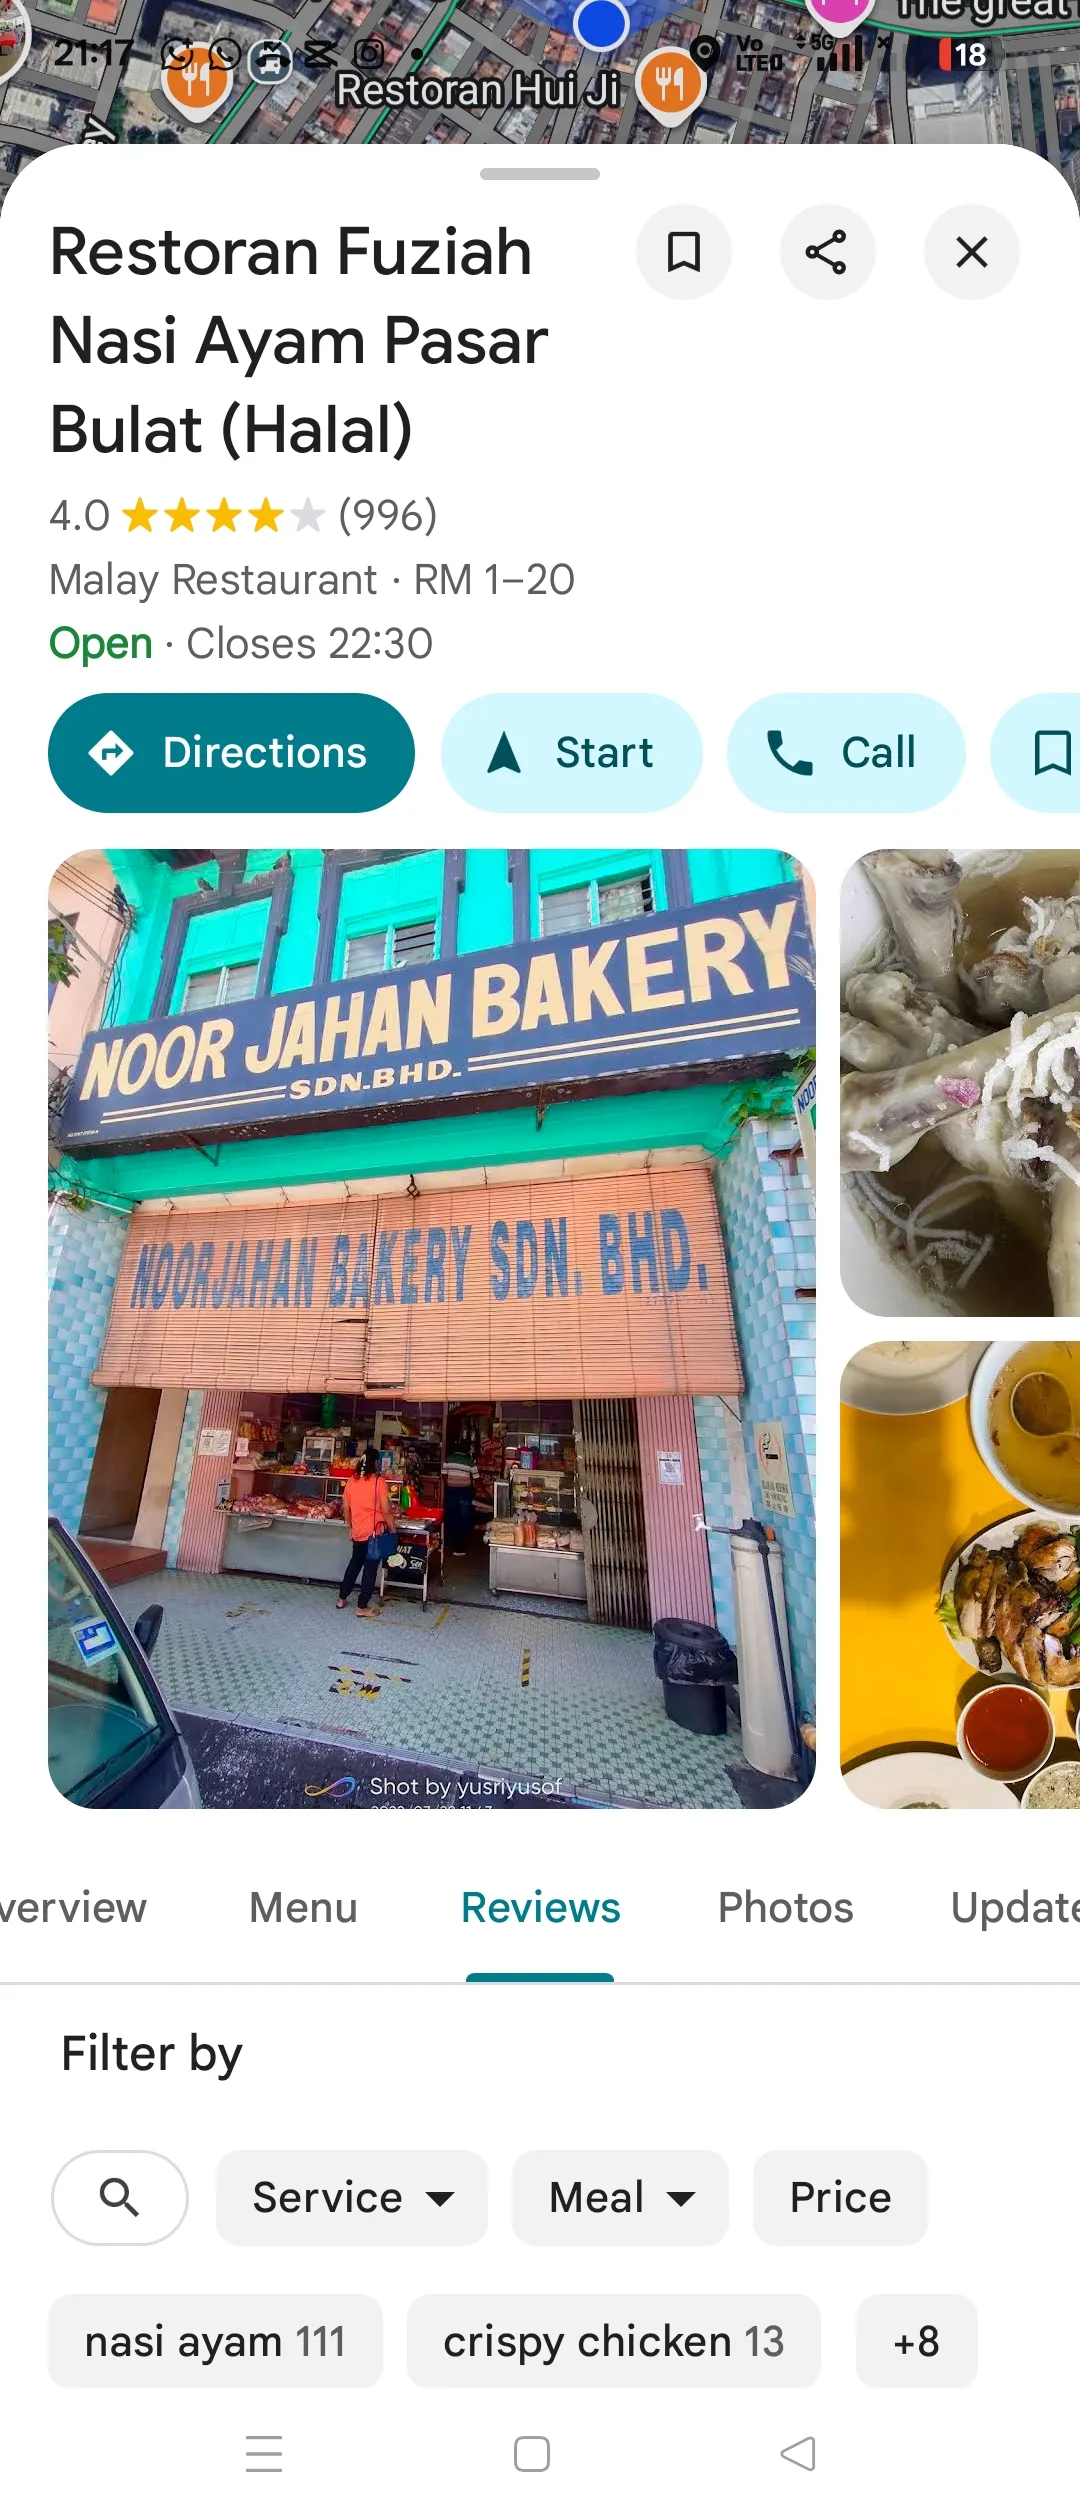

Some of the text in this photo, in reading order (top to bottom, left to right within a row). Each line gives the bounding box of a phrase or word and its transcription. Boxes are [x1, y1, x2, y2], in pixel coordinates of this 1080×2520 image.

[55, 39, 134, 66] 21:17
[737, 35, 763, 51] Vo
[812, 34, 834, 50] 5G
[955, 43, 986, 66] 18
[339, 72, 620, 105] Restoran Hui Ji
[53, 226, 531, 275] Restoran Fuziah
[53, 315, 549, 377] Nasi Ayam Pasar
[53, 401, 411, 461] Bulat (Halal)
[50, 497, 436, 536] 4.0 (996)
[51, 561, 159, 603] Malay
[174, 564, 377, 595] Restaurant
[415, 564, 471, 595] RM
[50, 625, 433, 667] Open Closes 22:30
[165, 734, 367, 768] Directions
[557, 736, 653, 769] Start
[843, 734, 914, 769] Call
[80, 900, 797, 1100] NOOR JAHAN BAKERY
[130, 1208, 708, 1310] NOORJAHAN BAKERY SDN. BHD.
[251, 1892, 357, 1924] Menu
[463, 1889, 621, 1924] Reviews
[721, 1889, 854, 1924] Photos
[64, 2032, 244, 2081] Filter by
[254, 2179, 403, 2214] Service
[551, 2179, 643, 2214] Meal
[792, 2179, 892, 2214] Price
[87, 2323, 343, 2365] nasi ayam 111
[445, 2323, 784, 2365] crispy chicken 13
[894, 2325, 940, 2358] +8
